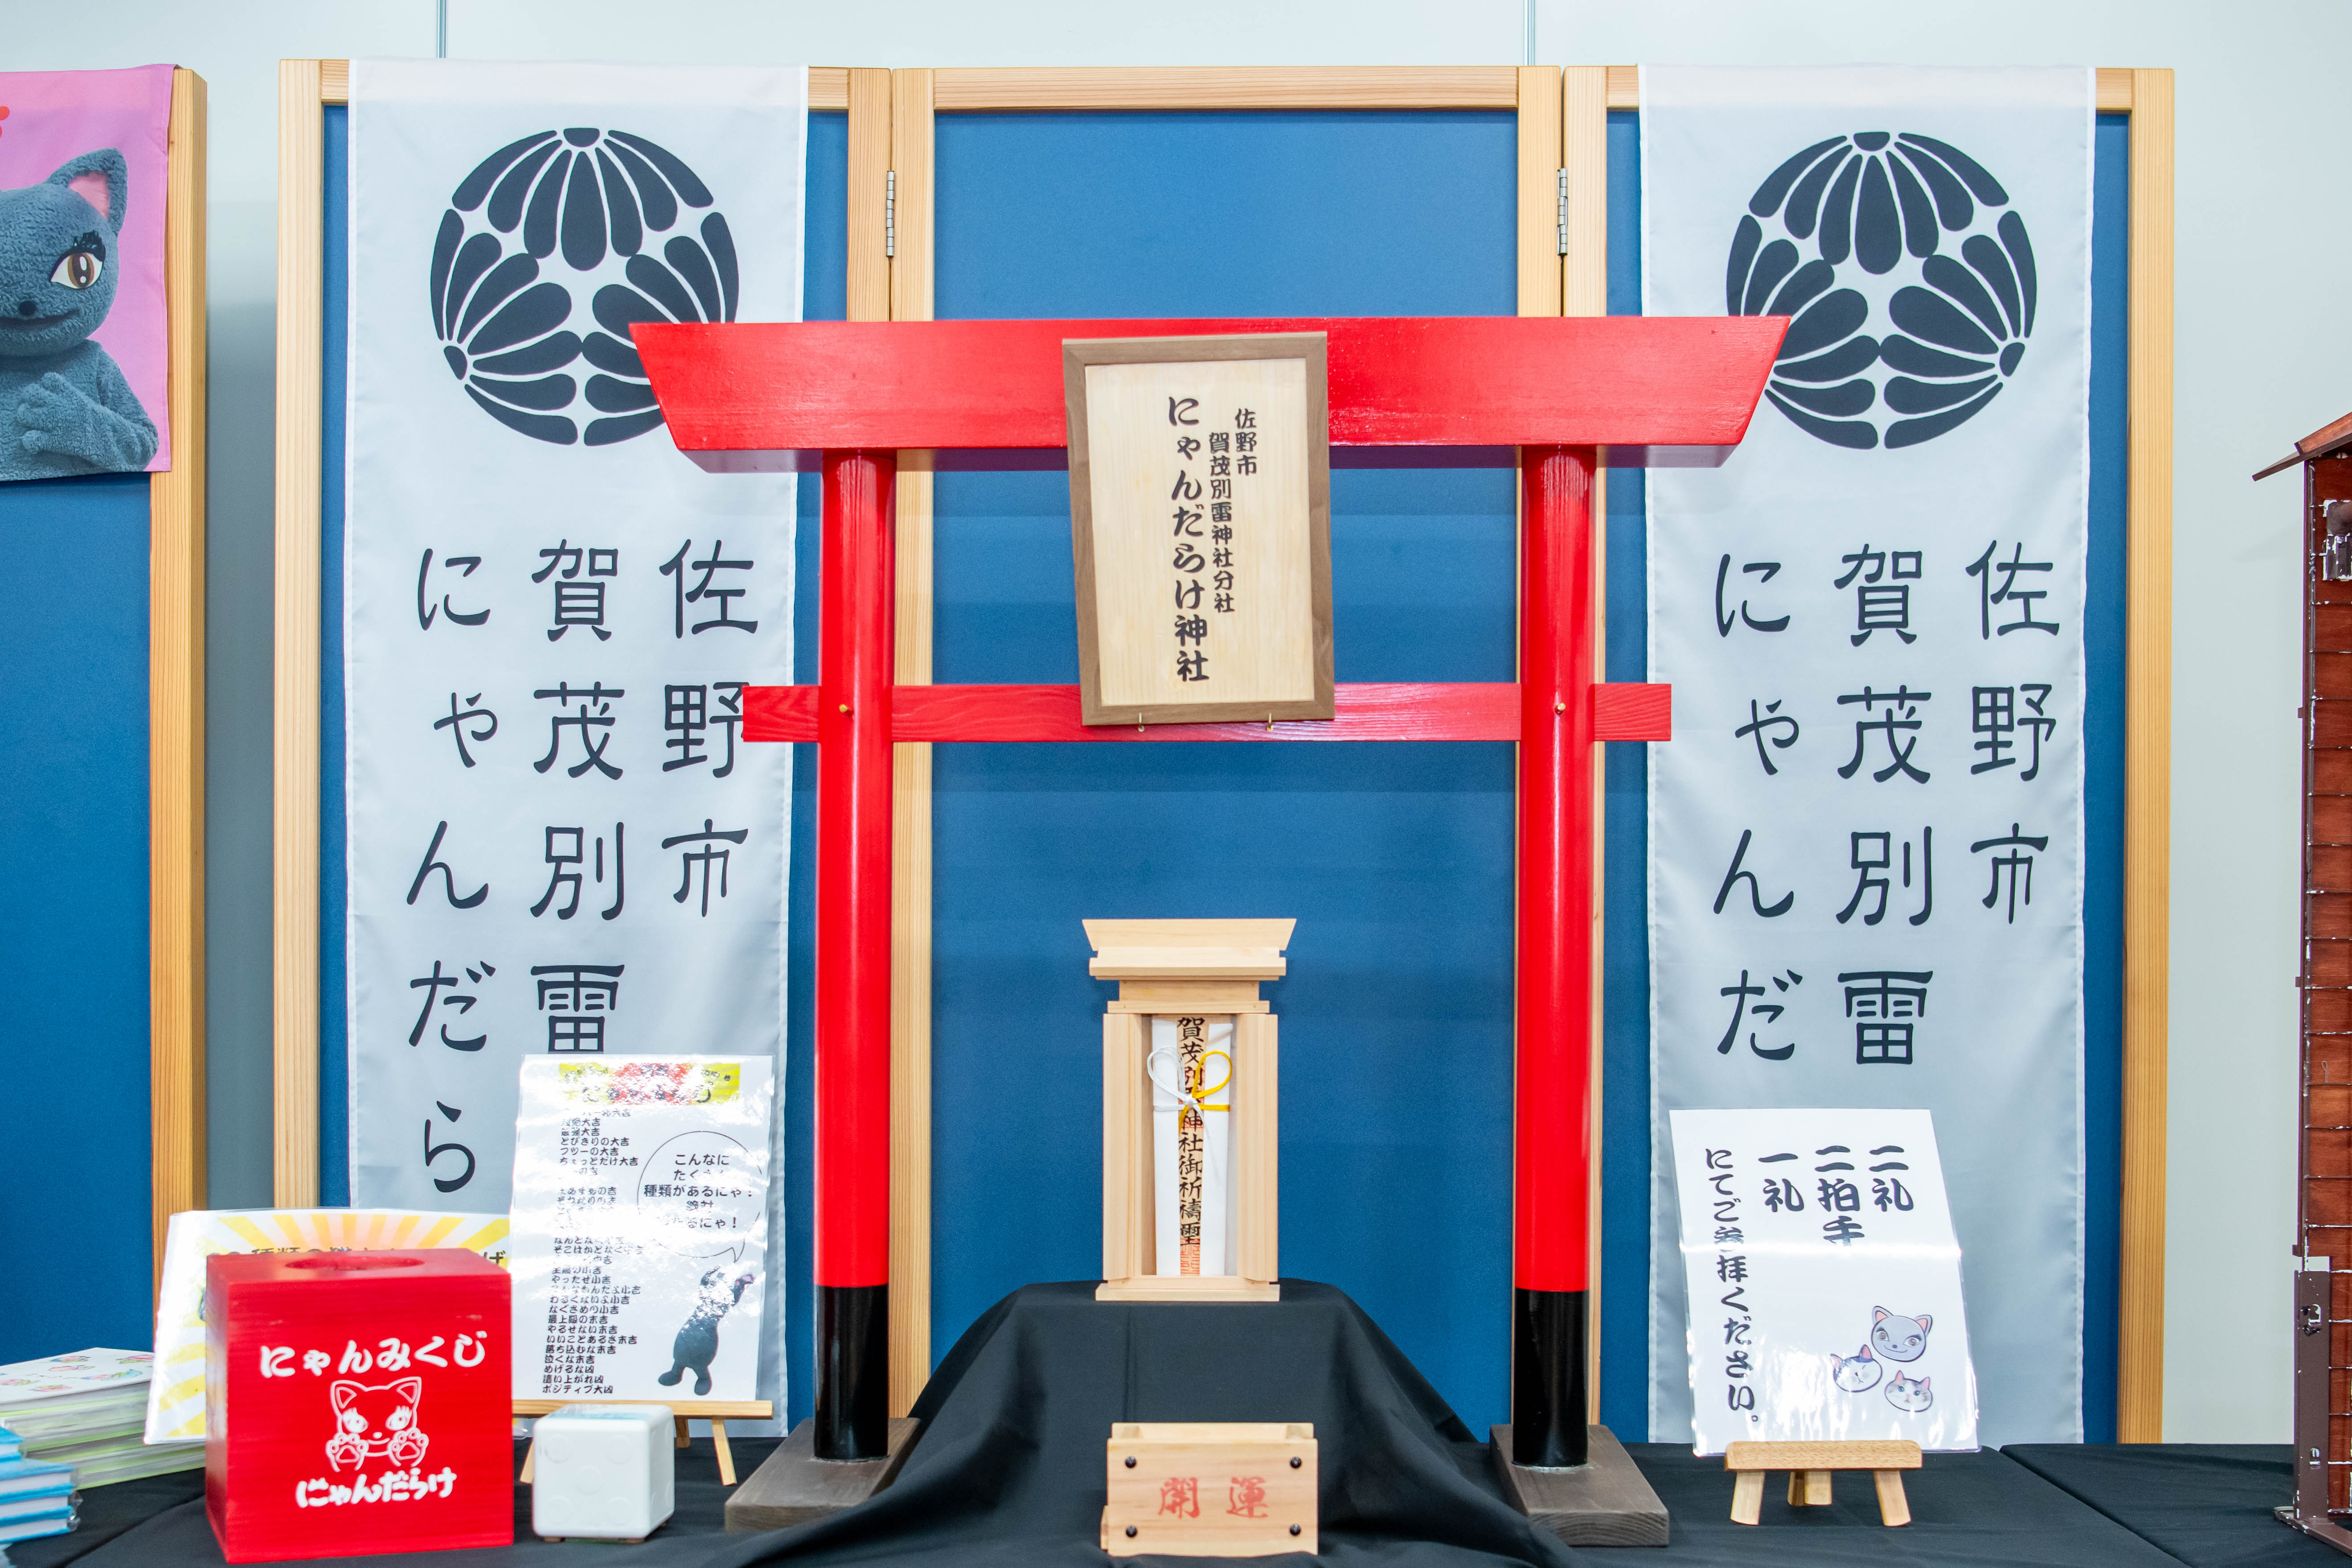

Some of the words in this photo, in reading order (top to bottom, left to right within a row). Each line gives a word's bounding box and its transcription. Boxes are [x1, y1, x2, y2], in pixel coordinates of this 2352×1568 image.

[1235, 408, 1257, 476] 佐野市
[1168, 396, 1209, 682] にゃんだらけ神社
[1209, 432, 1235, 614] 賀茂別雷神社分社
[659, 539, 758, 917] 佐野市
[1965, 540, 2060, 925] 佐野市
[530, 539, 625, 1053] 賀茂別雷
[1713, 554, 1803, 1061] にゃんだ
[1834, 544, 1934, 1065] 賀茂別雷
[406, 549, 498, 1193] にゃんだら
[561, 1137, 629, 1146] とびきりの大吉
[561, 1147, 619, 1156] フツーの大吉
[675, 1154, 730, 1166] こんなに
[1758, 1153, 1804, 1212] 一礼
[1815, 1145, 1864, 1247] 二拍手
[1868, 1145, 1914, 1212] 二礼
[550, 1295, 630, 1305] わるくないよ小吉
[552, 1275, 611, 1284] やったぜ小吉
[1705, 1148, 1758, 1423] にてご参拝ください。
[547, 1325, 618, 1335] やるせない末吉
[549, 1305, 619, 1314] なぐさめの小吉
[260, 1331, 488, 1377] にゃんみくじ
[545, 1345, 616, 1355] 落ち込むな末吉
[545, 1355, 595, 1364] 泣くな末吉
[547, 1335, 638, 1344] いいことあるさ末吉
[542, 1384, 614, 1395] ポジティブ大凶
[544, 1365, 594, 1374] めげるな凶
[295, 1466, 457, 1508] にゃんだらけ
[1158, 1476, 1269, 1519] 開運
